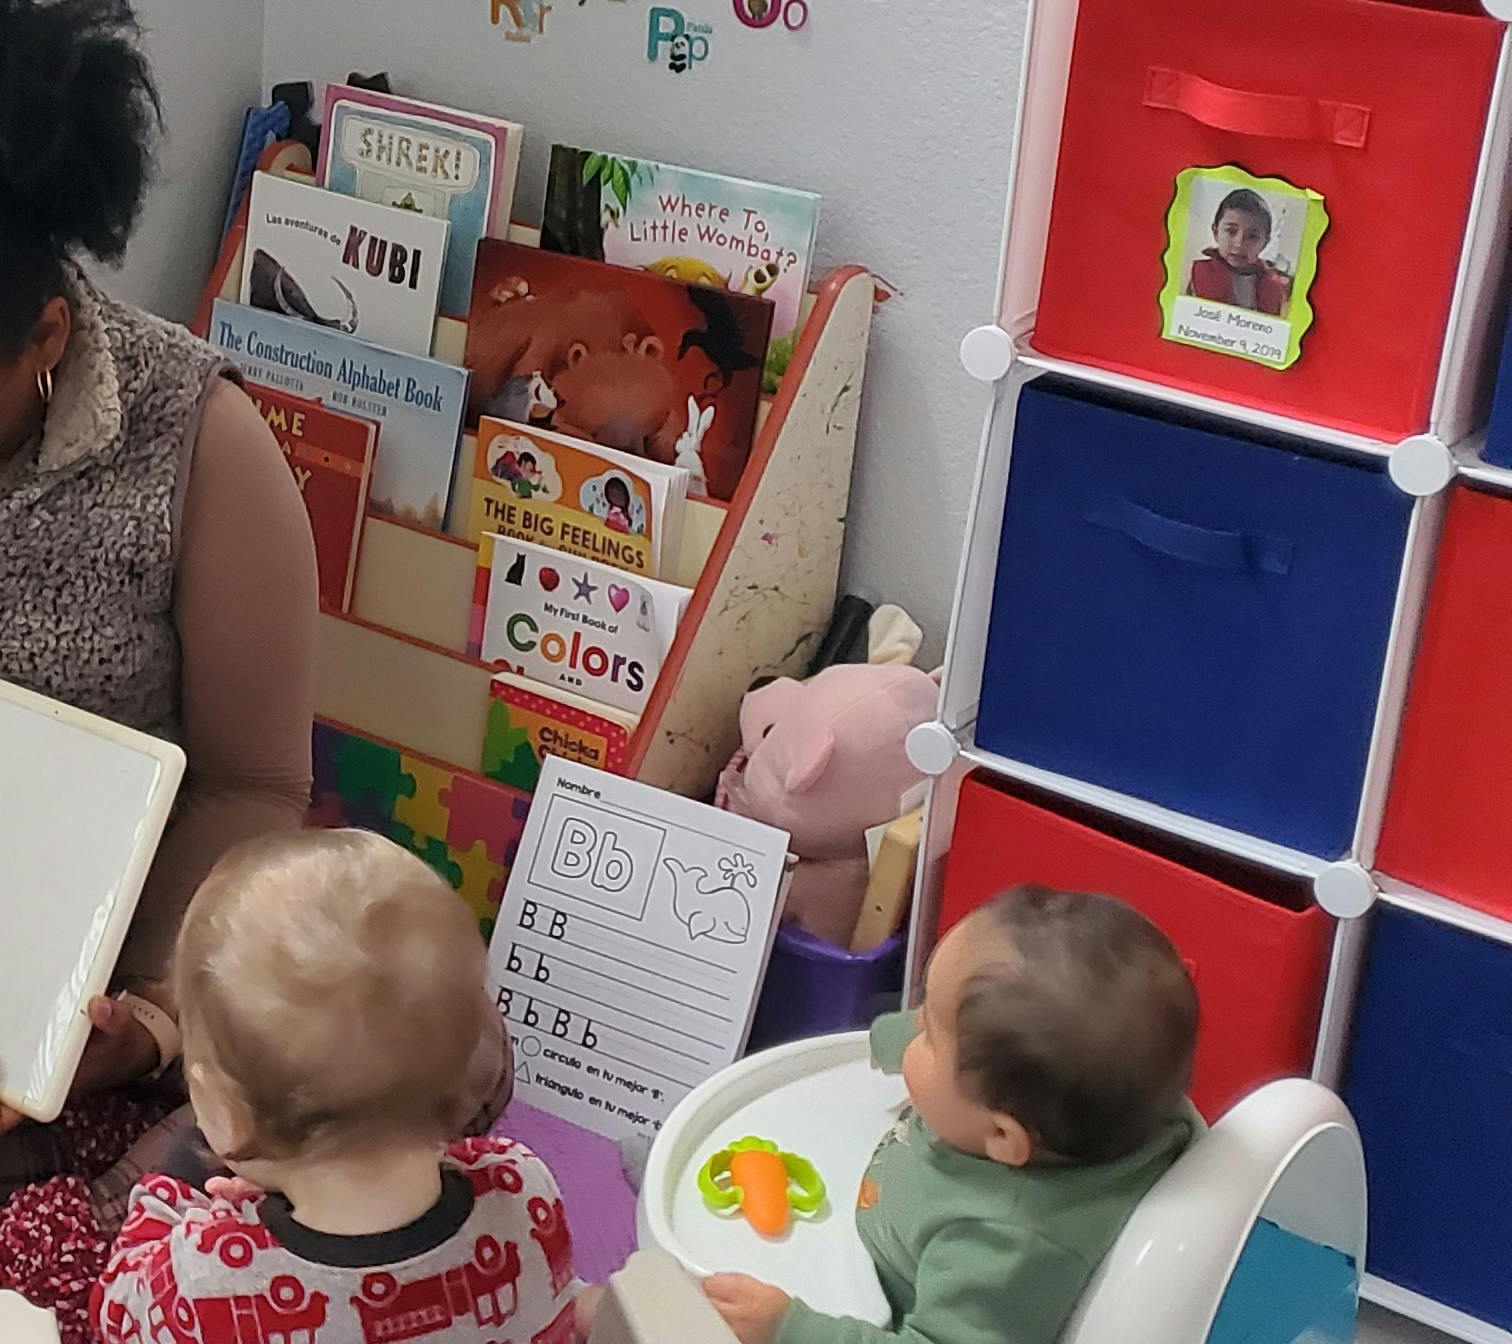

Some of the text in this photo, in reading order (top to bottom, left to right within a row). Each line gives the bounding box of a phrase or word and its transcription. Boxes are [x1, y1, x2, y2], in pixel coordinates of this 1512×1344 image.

[357, 127, 463, 181] SHREK!
[266, 213, 342, 246] Las aventuras de
[658, 194, 770, 242] Where To,
[342, 225, 422, 289] KUBI
[630, 220, 796, 274] Little Wombat?
[1194, 306, 1273, 334] José Moreno
[1178, 324, 1236, 348] November
[1252, 342, 1282, 360] 2019
[219, 321, 443, 412] The Construction Alphabet Book
[484, 498, 516, 524] THE
[522, 511, 554, 536] BIG
[560, 522, 645, 568] FEELINGS
[544, 603, 619, 634] My First Book of
[506, 613, 644, 692] Colors
[559, 674, 583, 686] AND
[539, 726, 599, 760] Chicka
[556, 777, 601, 799] Nombre
[551, 816, 634, 893] Bb
[519, 900, 567, 940] B B
[586, 1064, 600, 1078] en
[602, 1070, 614, 1082] tu
[615, 1076, 648, 1094] mejor
[588, 1094, 602, 1108] en
[604, 1100, 616, 1112] tu
[618, 1106, 650, 1126] mejor
